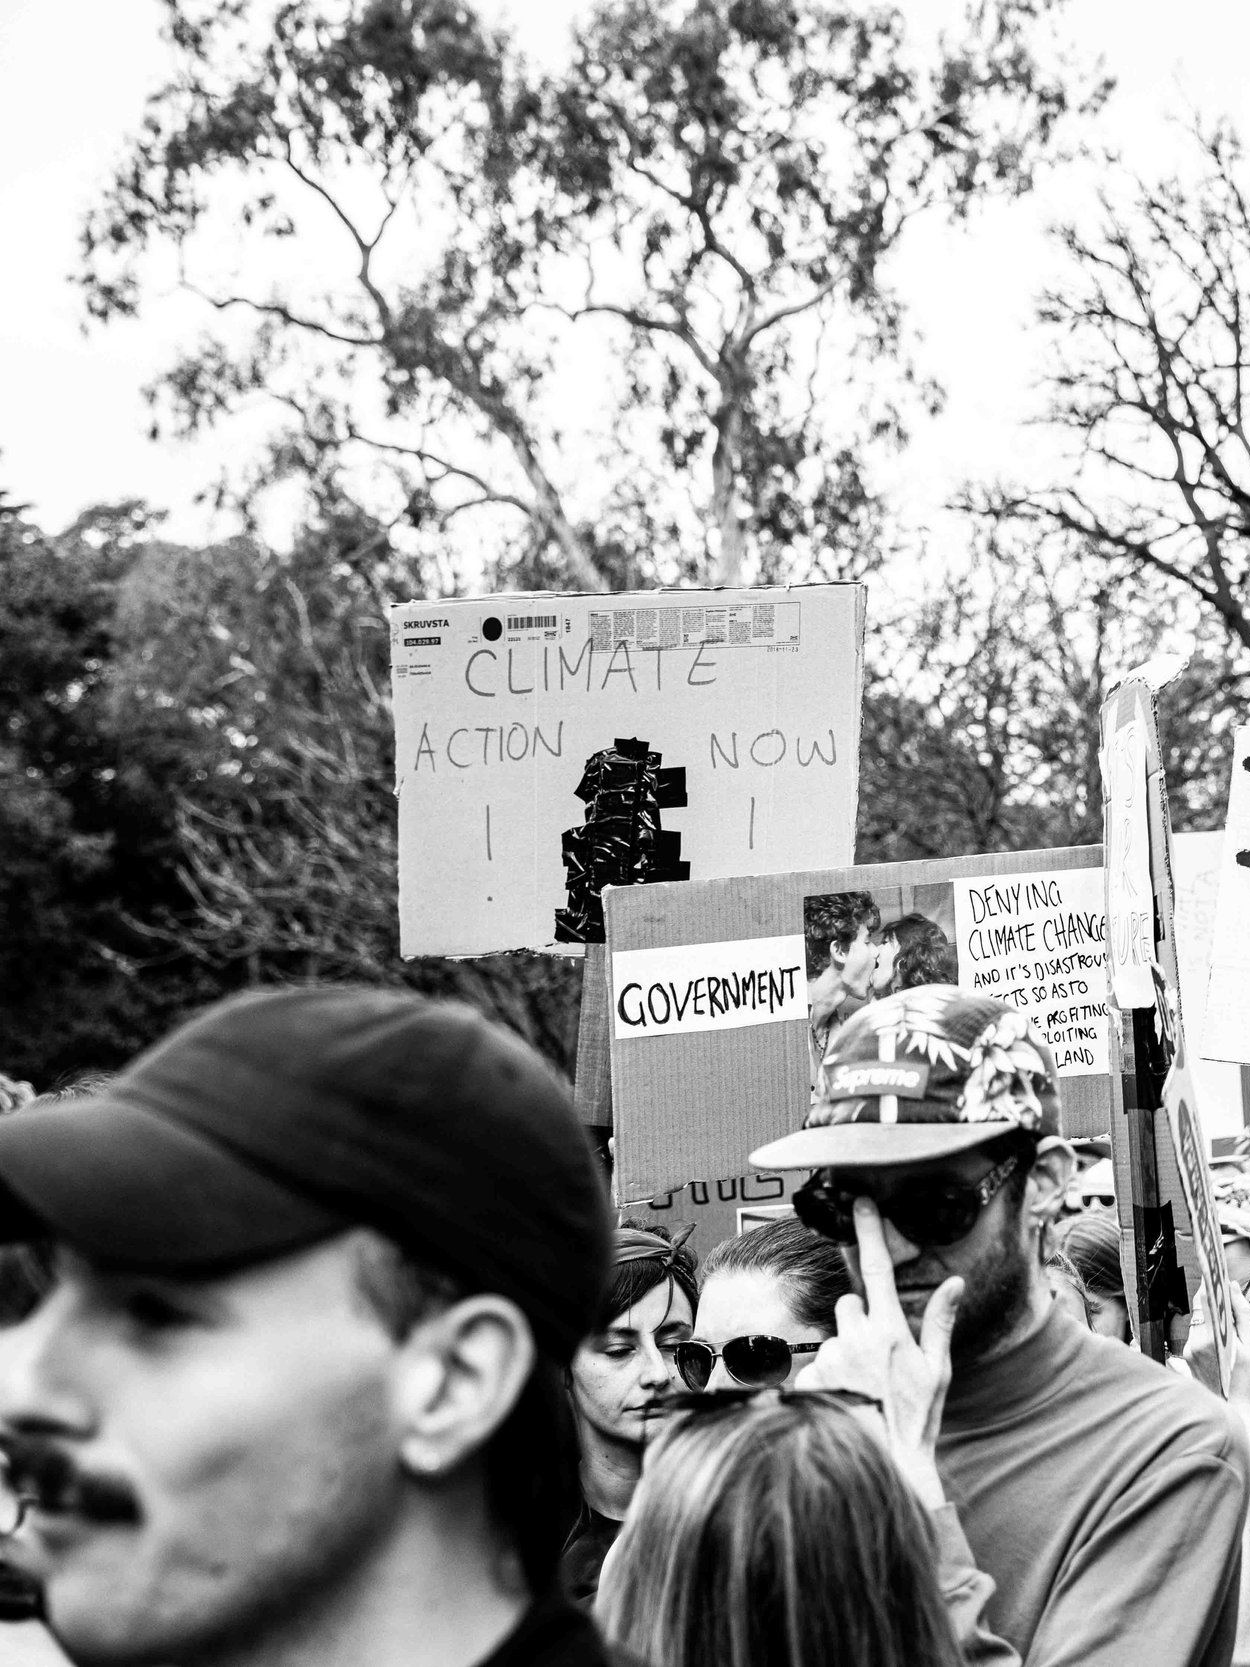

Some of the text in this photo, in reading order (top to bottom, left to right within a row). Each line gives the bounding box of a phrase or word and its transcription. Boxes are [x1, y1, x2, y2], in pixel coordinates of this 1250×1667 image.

[403, 619, 450, 629] SKRUVSTA
[465, 638, 717, 697] CLIMATE
[415, 721, 837, 772] ACTION NOW
[969, 880, 1063, 924] DENYING
[968, 923, 1036, 961] CLIMATE
[974, 968, 1001, 989] AND
[1005, 963, 1031, 980] IT'S
[1032, 986, 1048, 1003] SO
[1051, 983, 1068, 998] AS
[1069, 980, 1088, 996] TO
[618, 966, 801, 1026] GOVERNMENT
[1055, 1047, 1094, 1068] LAND
